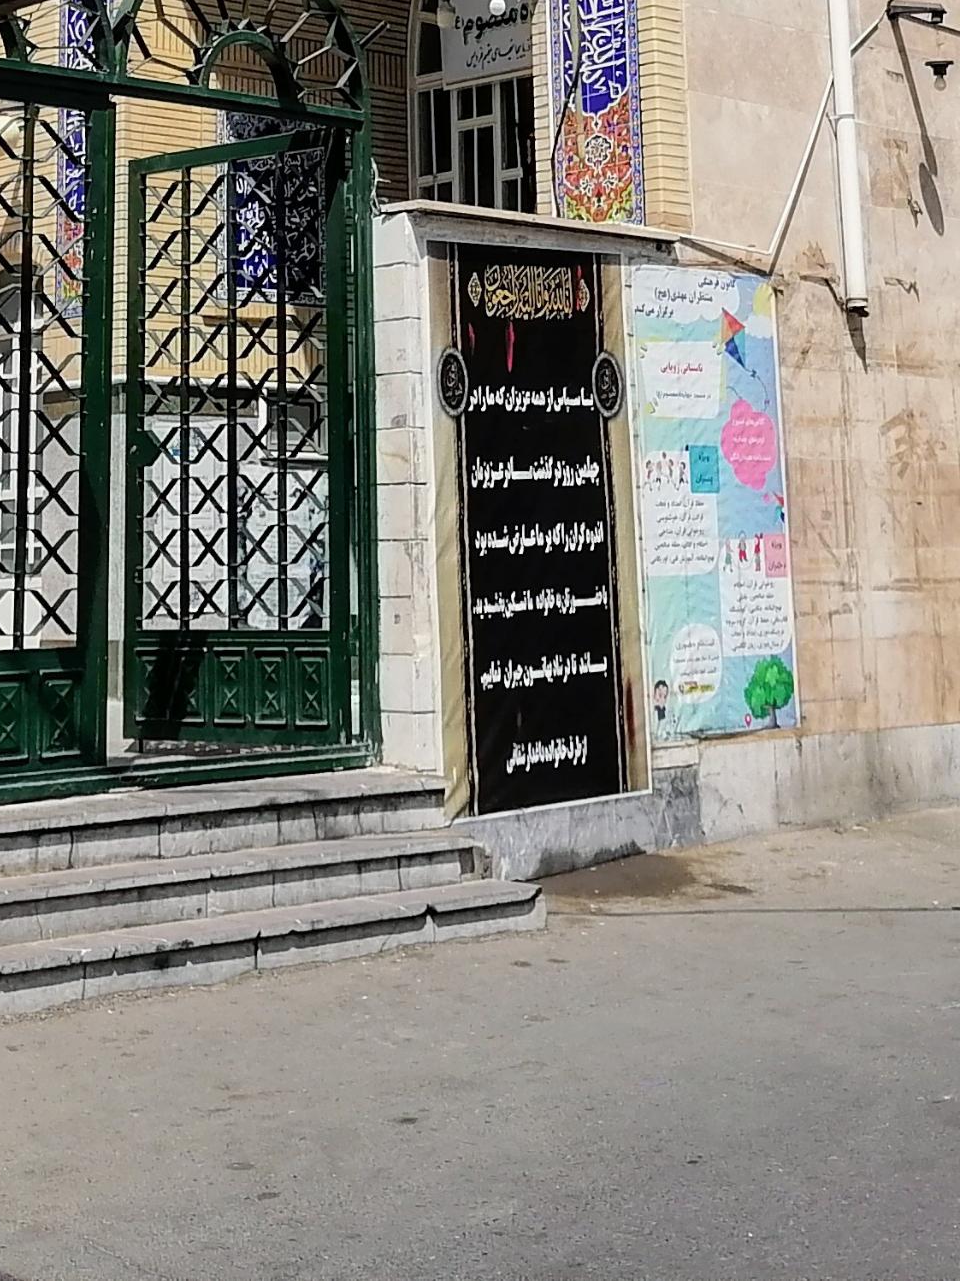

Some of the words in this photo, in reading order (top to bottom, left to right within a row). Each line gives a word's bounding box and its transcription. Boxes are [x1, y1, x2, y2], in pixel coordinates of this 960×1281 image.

[698, 277, 719, 289] فرهنگی
[495, 385, 506, 406] که
[505, 385, 531, 412] عزیزان
[531, 390, 546, 406] همه
[546, 386, 554, 412] از
[553, 386, 581, 413] سپاس
[581, 386, 594, 411] با
[562, 460, 575, 487] روز
